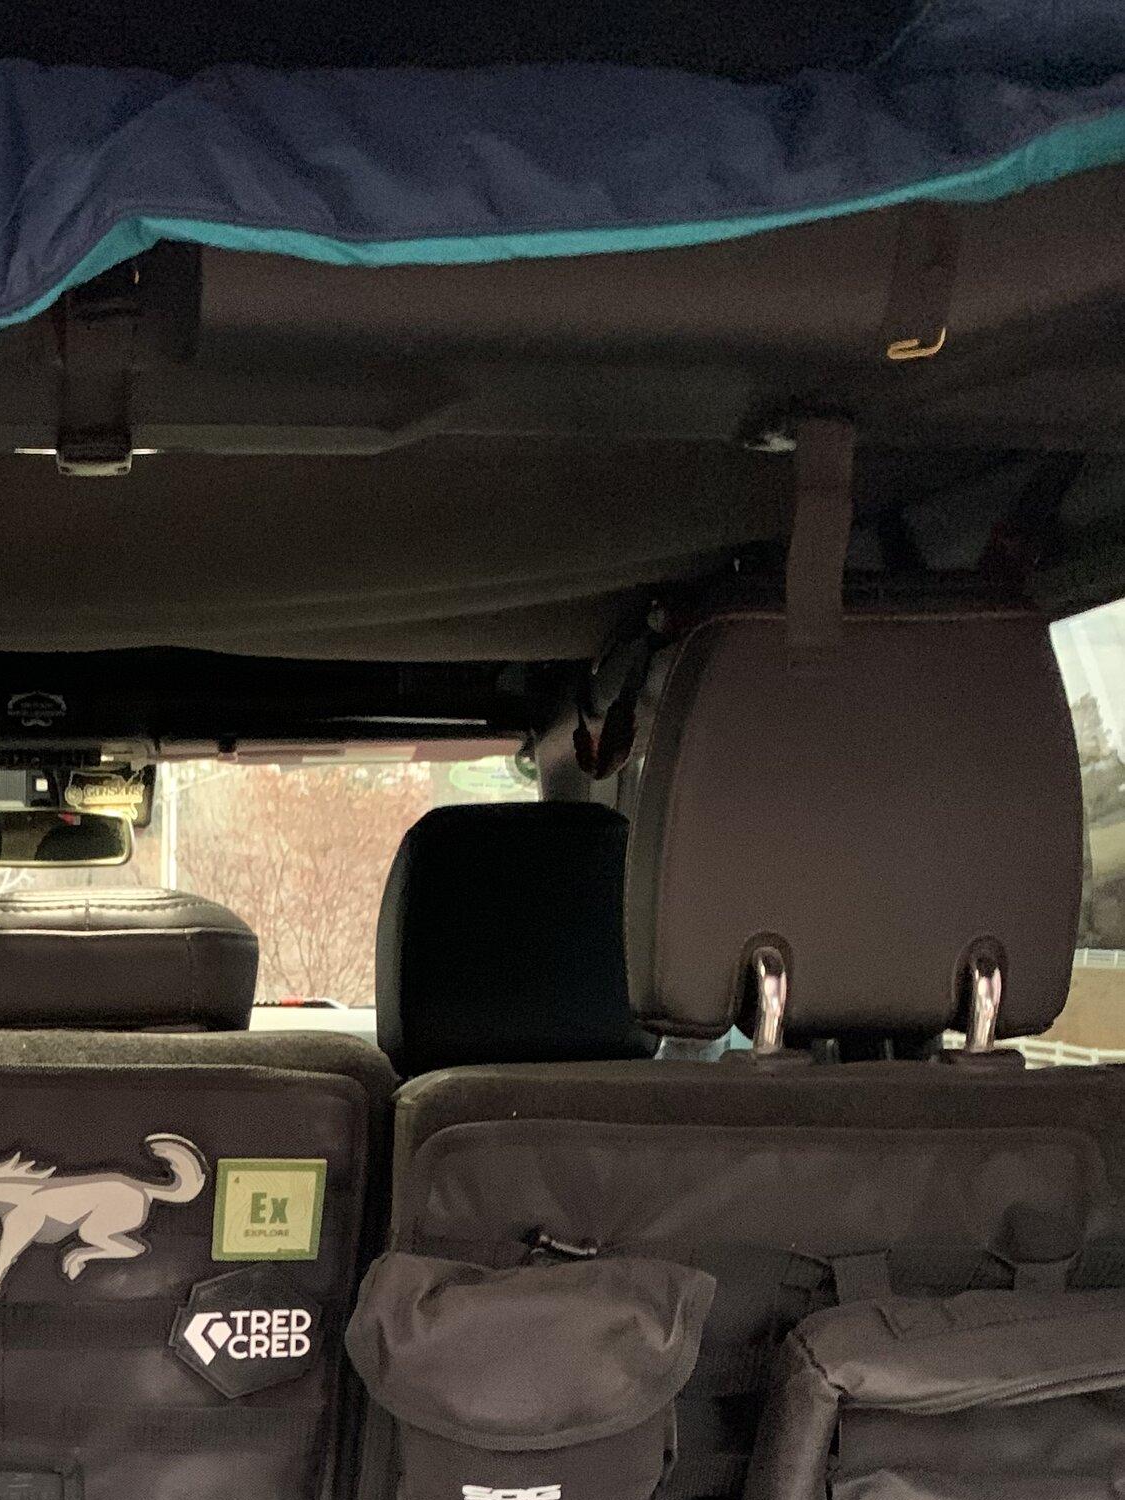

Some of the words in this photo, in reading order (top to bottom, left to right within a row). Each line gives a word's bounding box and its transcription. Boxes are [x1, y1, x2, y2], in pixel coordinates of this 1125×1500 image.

[250, 1192, 290, 1224] Ex
[244, 1229, 290, 1238] EXPLORE
[229, 1308, 312, 1335] TRED
[227, 1333, 311, 1360] CRED
